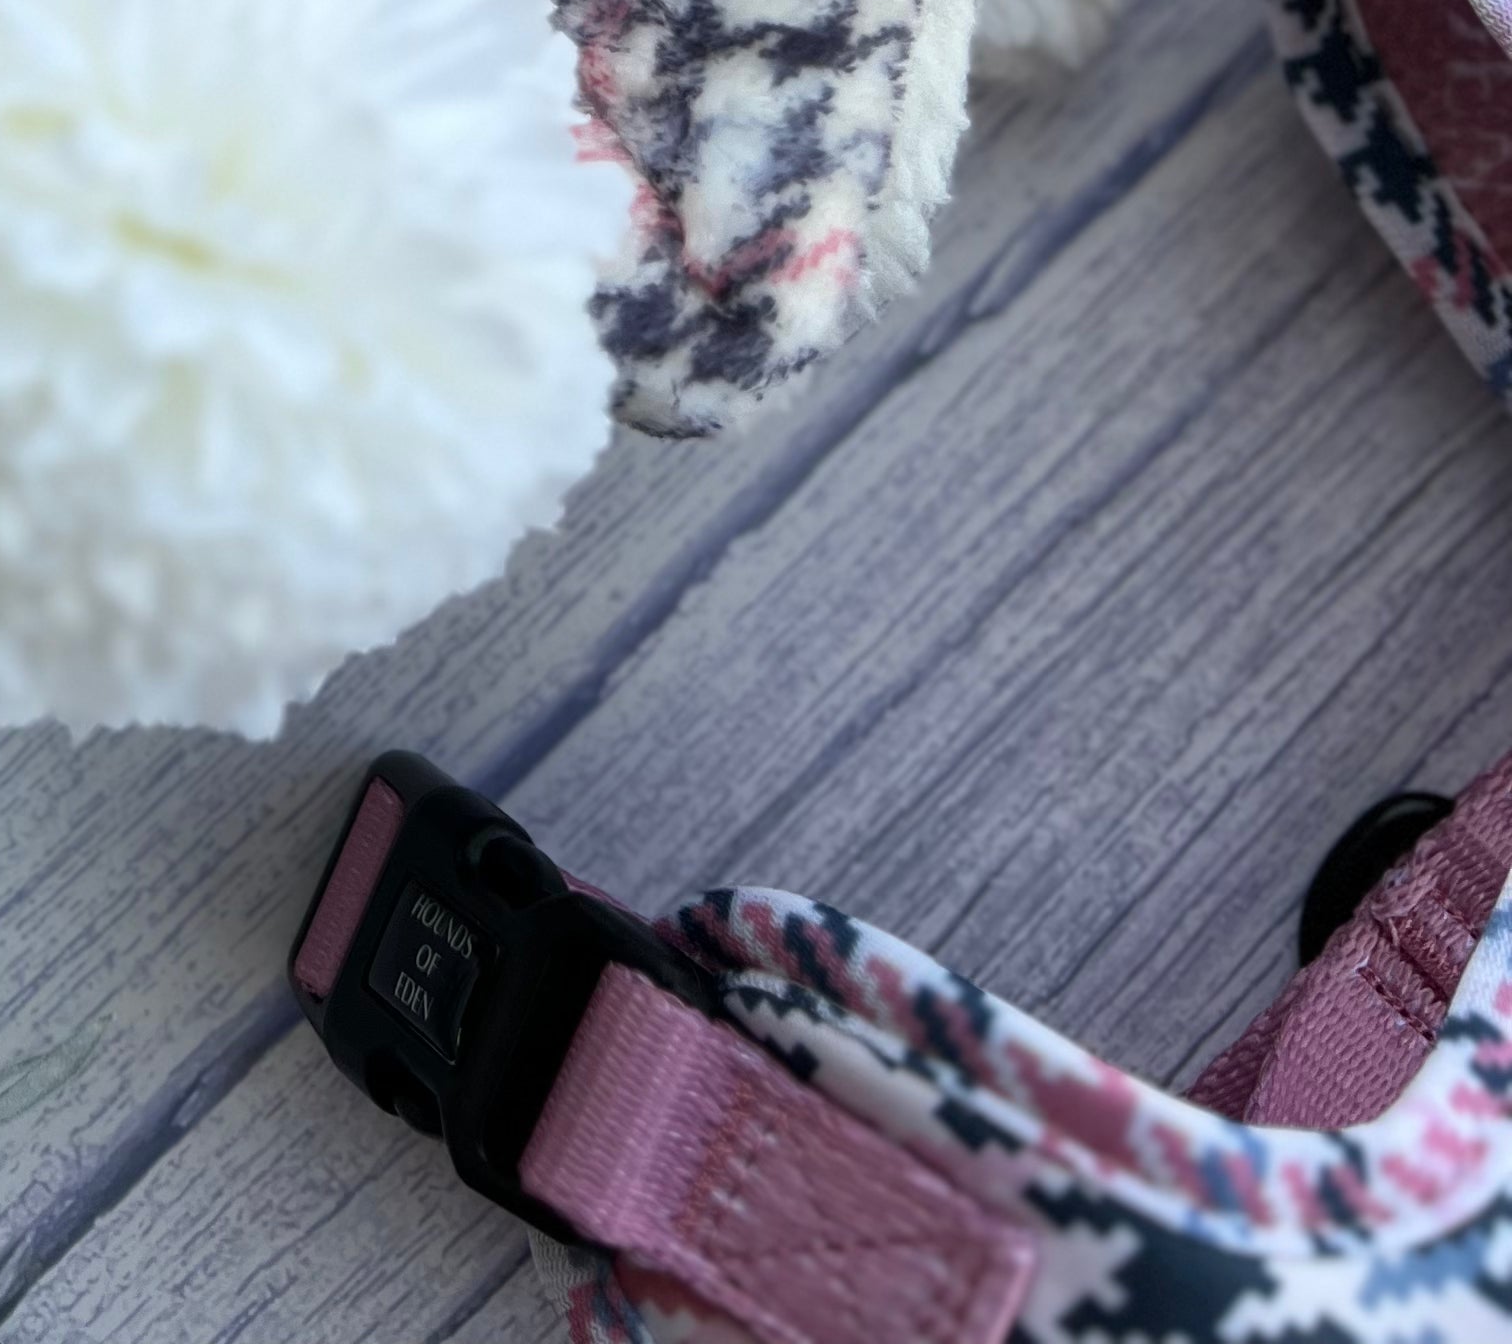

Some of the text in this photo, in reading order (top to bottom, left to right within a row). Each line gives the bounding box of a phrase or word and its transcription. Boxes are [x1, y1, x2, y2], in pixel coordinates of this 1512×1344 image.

[411, 894, 476, 959] HOUNDS
[416, 943, 442, 976] OF
[394, 971, 435, 1021] EDEN
